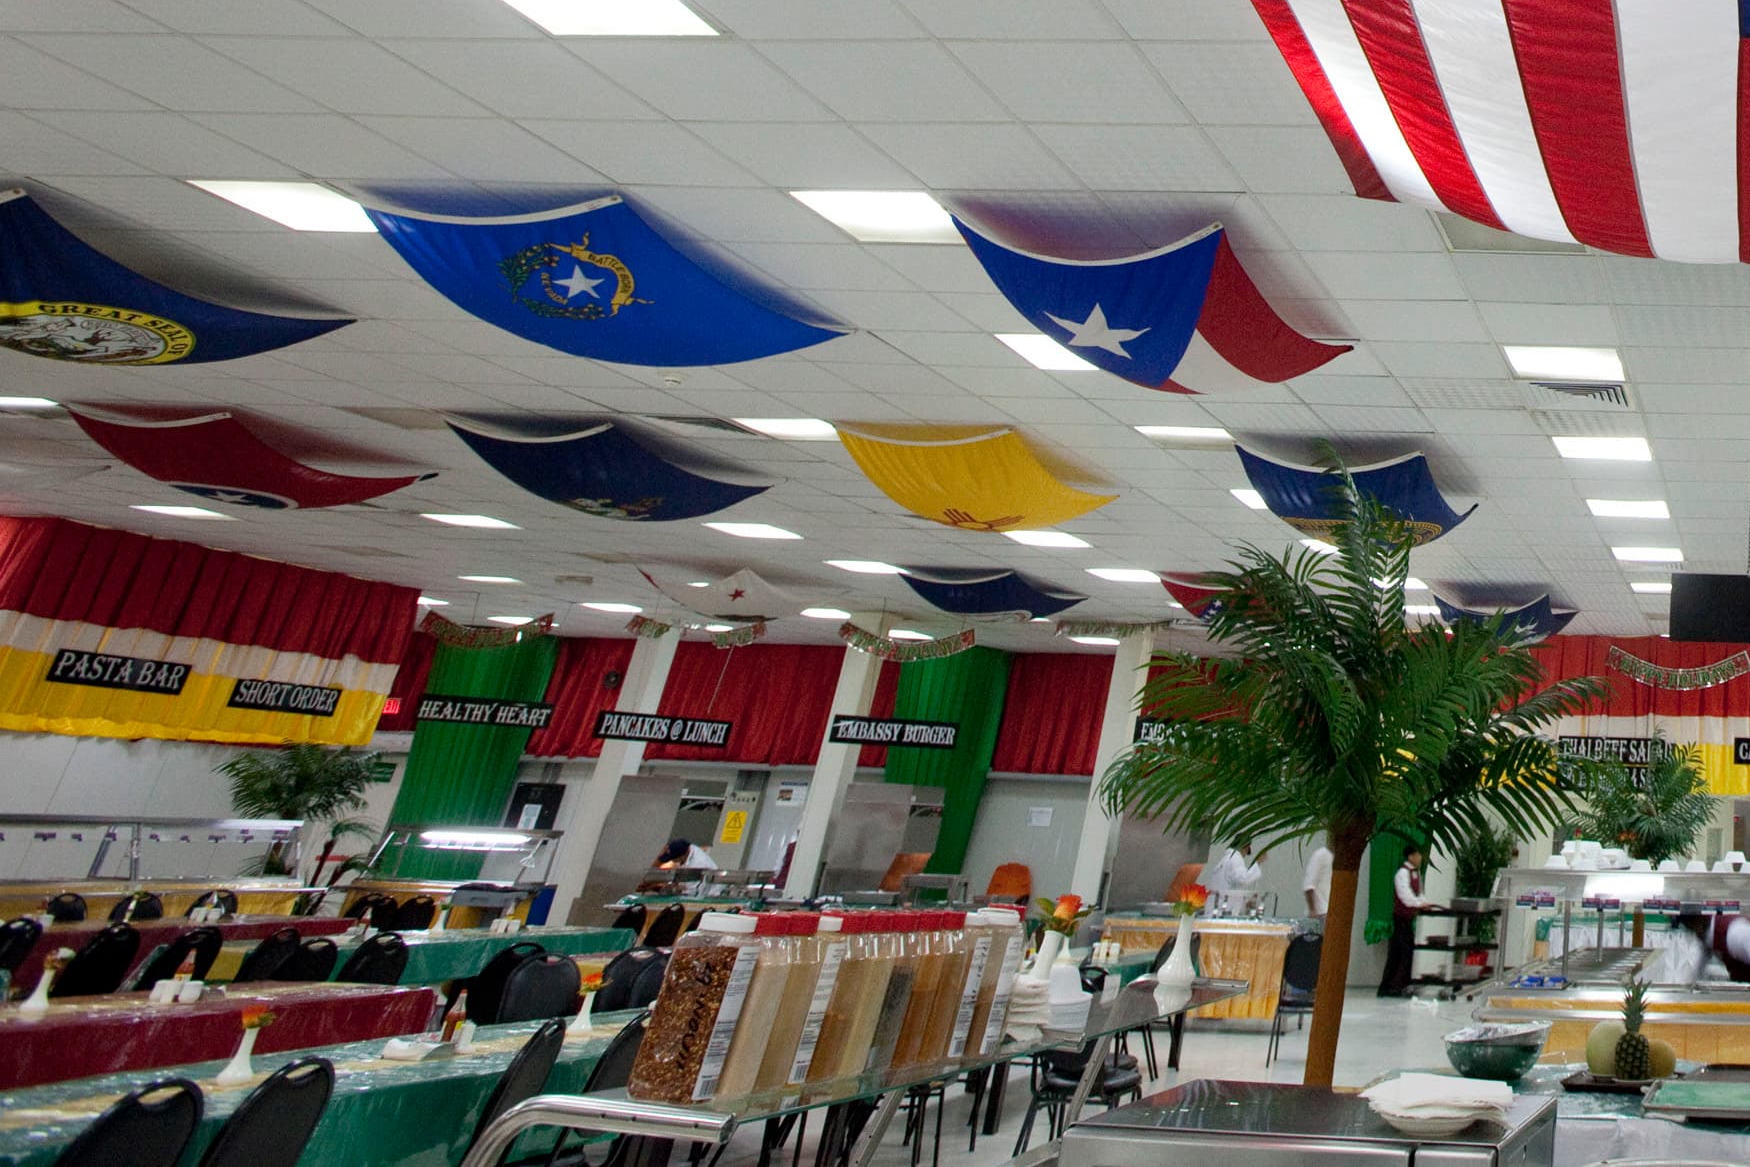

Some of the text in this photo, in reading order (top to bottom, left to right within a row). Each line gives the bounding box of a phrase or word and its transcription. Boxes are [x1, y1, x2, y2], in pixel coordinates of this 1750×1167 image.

[38, 304, 190, 357] GREAT SEAL OF
[54, 651, 185, 690] PASTA BAR
[1620, 656, 1737, 688] HAPPY HOLIDAYS
[234, 680, 339, 713] SHORT ORDER
[417, 700, 552, 727] HEALTHY HEART
[599, 714, 729, 744] PANCAKES @ LUNCH
[836, 720, 956, 746] EMBASSY BURGER
[1594, 738, 1628, 763] BEEF
